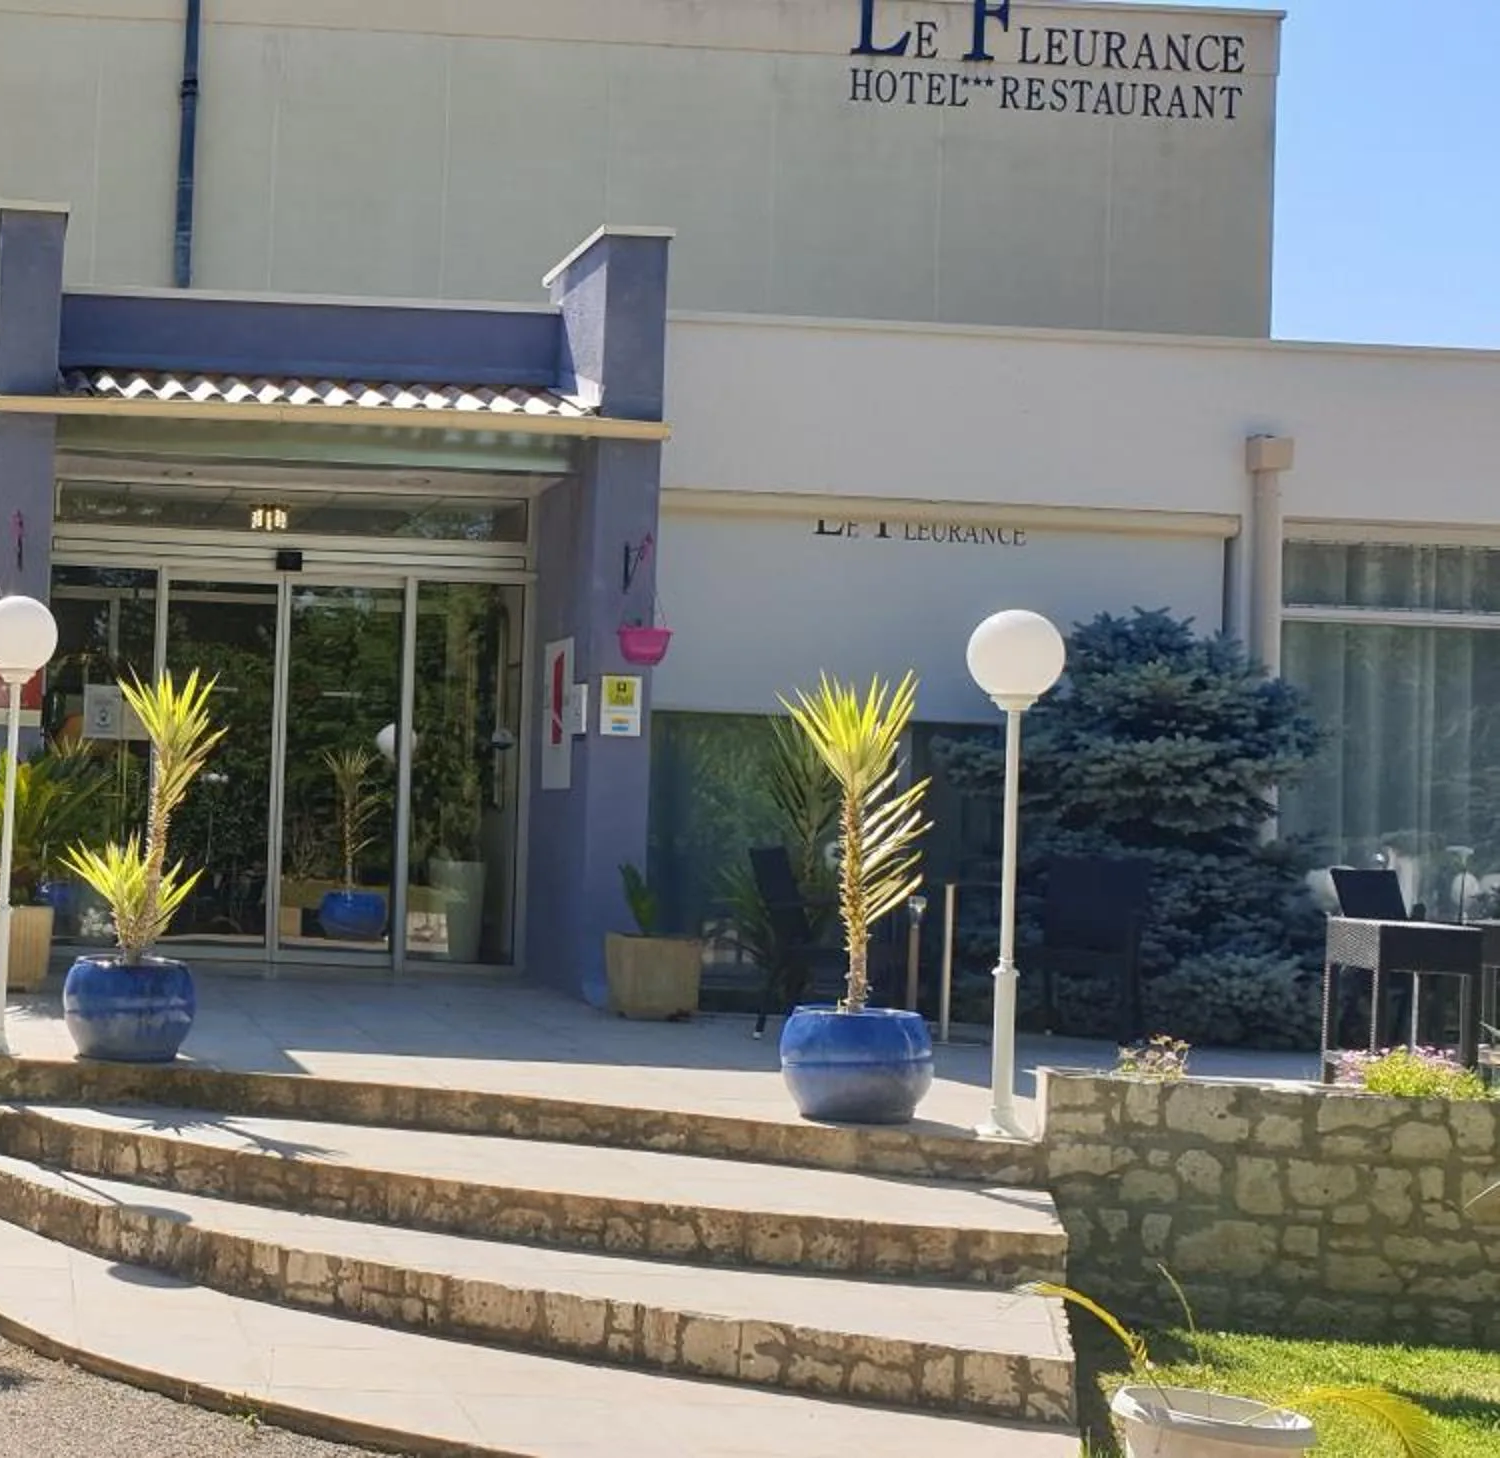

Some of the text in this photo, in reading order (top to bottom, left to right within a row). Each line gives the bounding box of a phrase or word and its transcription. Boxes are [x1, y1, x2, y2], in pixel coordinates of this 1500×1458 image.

[850, 68, 1243, 119] HOTEL RESTAURANT
[874, 521, 1028, 547] LEURANCE
